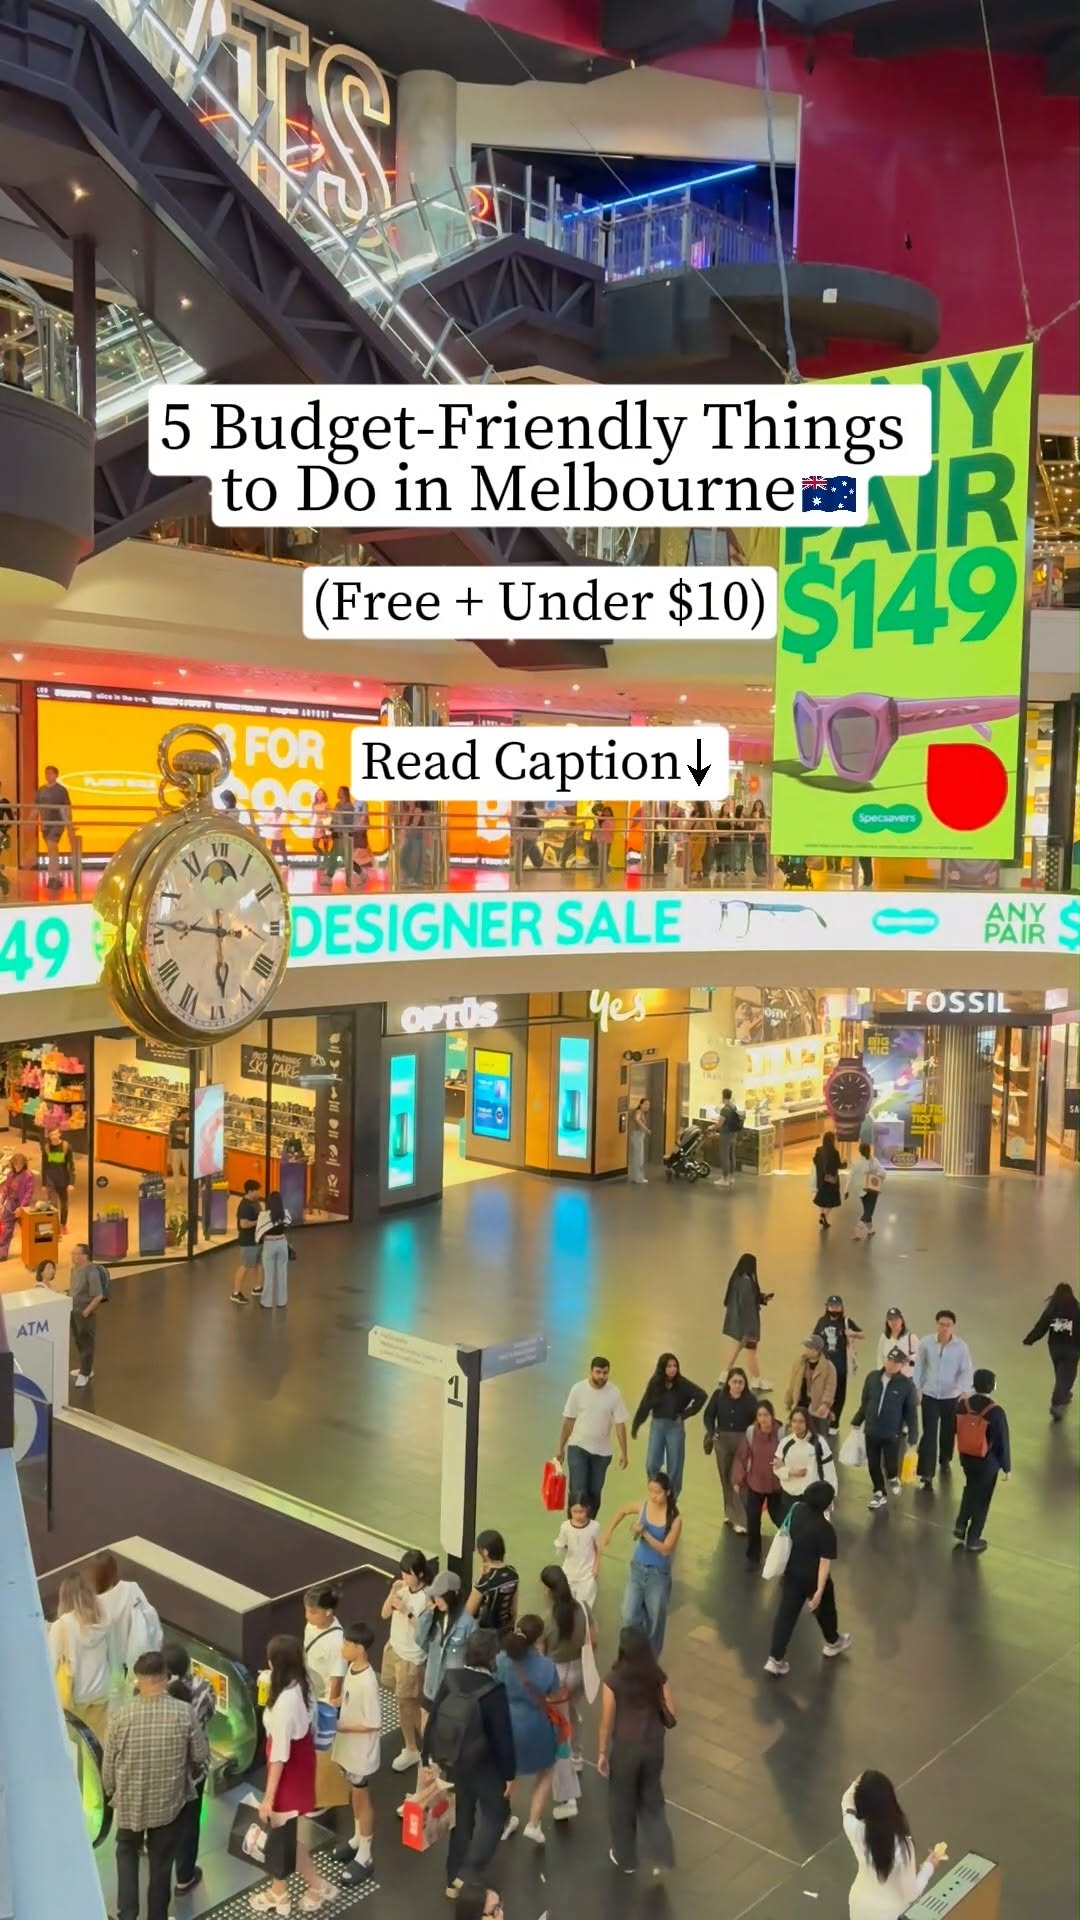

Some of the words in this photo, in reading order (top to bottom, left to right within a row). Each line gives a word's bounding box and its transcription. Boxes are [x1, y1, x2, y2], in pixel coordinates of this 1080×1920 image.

[781, 546, 1018, 664] $149
[245, 727, 325, 770] FOR
[858, 812, 917, 825] Specsavers
[985, 901, 1047, 923] ANY
[288, 899, 543, 960] DESIGNER
[555, 898, 683, 948] SALE
[983, 922, 1046, 945] PAIR
[906, 991, 1012, 1014] FOSSIL
[400, 996, 499, 1034] OPTUS
[247, 1059, 268, 1075] SKI
[16, 1319, 50, 1339] ATM
[447, 1375, 464, 1408] 1
